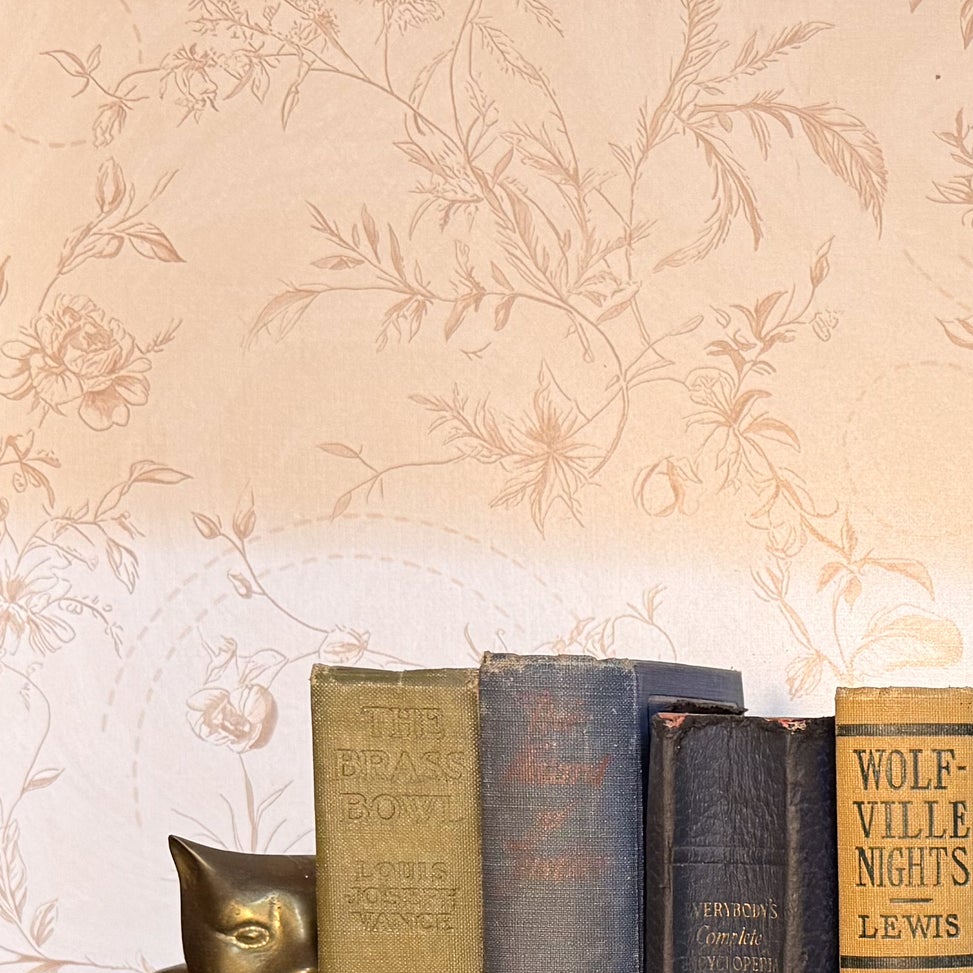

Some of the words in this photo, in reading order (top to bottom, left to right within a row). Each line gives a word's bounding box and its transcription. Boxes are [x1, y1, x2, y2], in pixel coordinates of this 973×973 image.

[360, 705, 445, 739] THE
[335, 748, 467, 783] BRASS
[853, 749, 968, 790] WOLF-
[339, 792, 466, 824] BOWL
[853, 801, 970, 839] VILLE
[354, 861, 449, 882] LOUIS
[855, 846, 970, 887] NIGHTS
[350, 911, 454, 932] VANCE
[686, 899, 778, 919] VERYBODY'S
[858, 914, 961, 939] LEWIS
